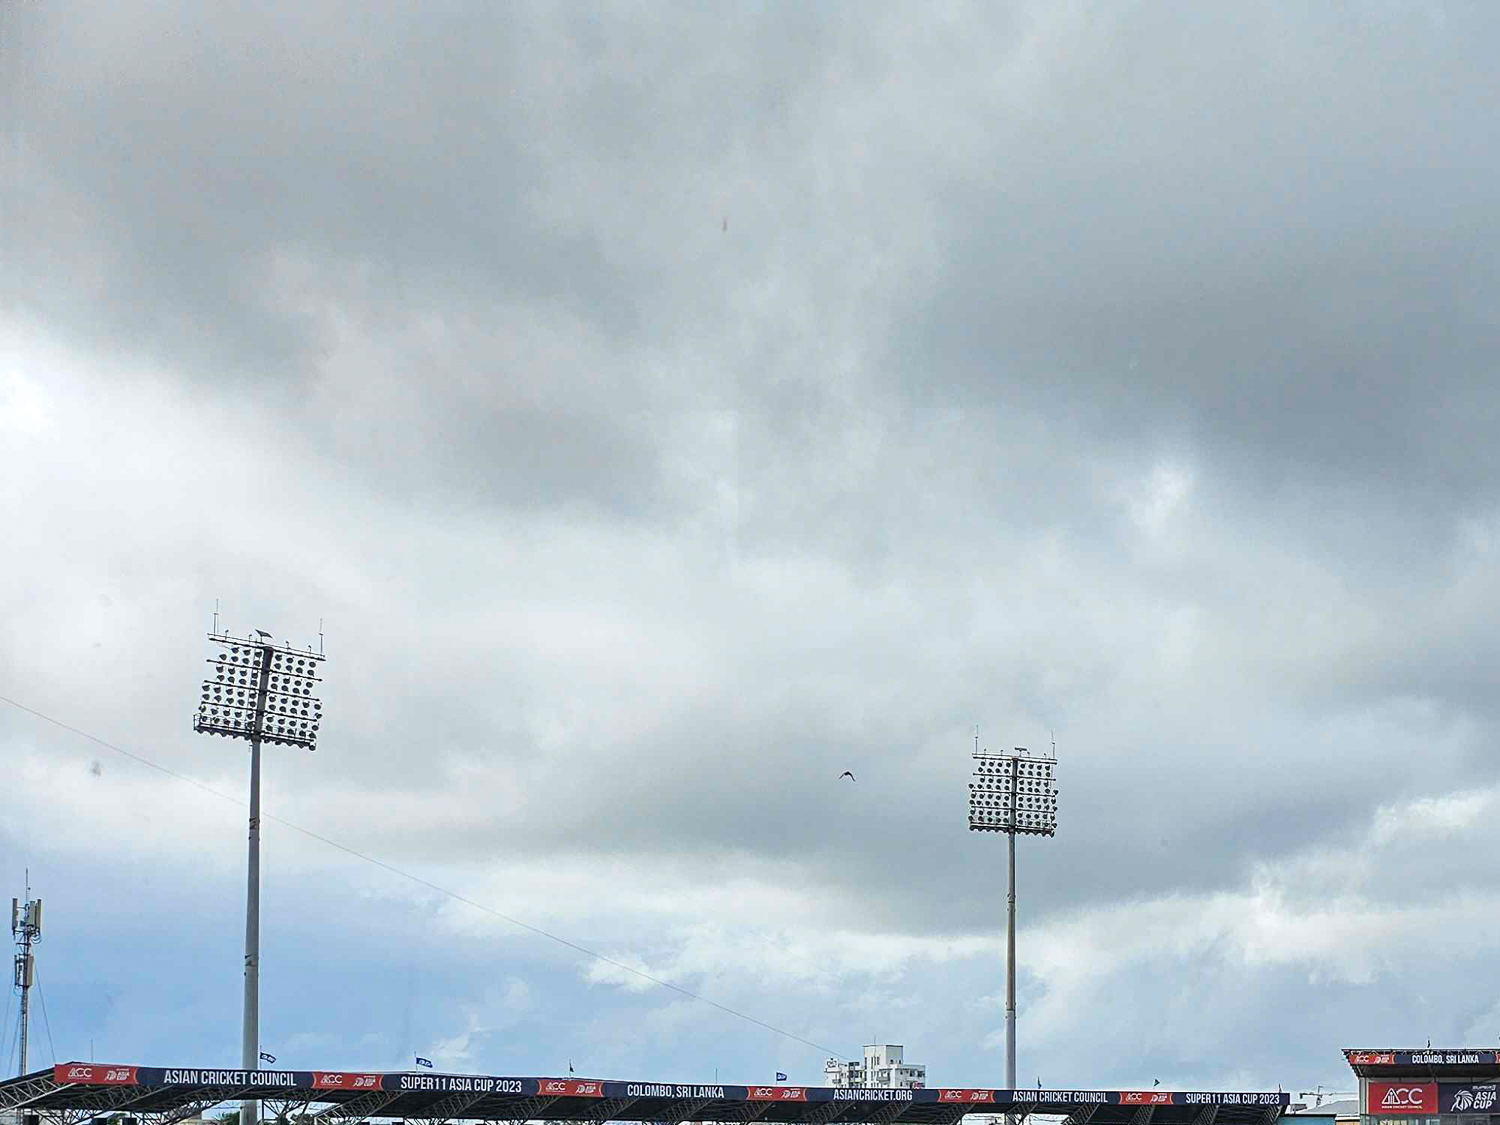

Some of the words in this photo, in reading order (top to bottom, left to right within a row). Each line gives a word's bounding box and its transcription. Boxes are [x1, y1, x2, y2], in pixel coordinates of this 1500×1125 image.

[1456, 1055, 1479, 1064] LANKA
[164, 1070, 198, 1085] ASIAN
[201, 1070, 248, 1086] CRICKET
[250, 1071, 297, 1087] COUNCIL
[401, 1076, 447, 1091] SUPER11
[449, 1078, 472, 1092] ASIA
[474, 1078, 494, 1093] CUP
[496, 1079, 522, 1093] 2023
[627, 1084, 676, 1099] COLOMBO,
[676, 1086, 690, 1098] SRI
[692, 1087, 725, 1099] LANKA
[833, 1089, 913, 1101] ASIANCRICKET.ORG
[1012, 1091, 1037, 1102] ASIAN
[1039, 1092, 1073, 1103] CRICKET
[1075, 1092, 1108, 1103] COUNCIL
[1381, 1087, 1423, 1105] ACC
[1475, 1091, 1497, 1101] ASIA
[1185, 1093, 1221, 1104] SUPER11
[1222, 1094, 1241, 1104] ASIA
[1242, 1094, 1258, 1104] CUP
[1259, 1094, 1279, 1104] 2023
[1473, 1100, 1493, 1109] CUP
